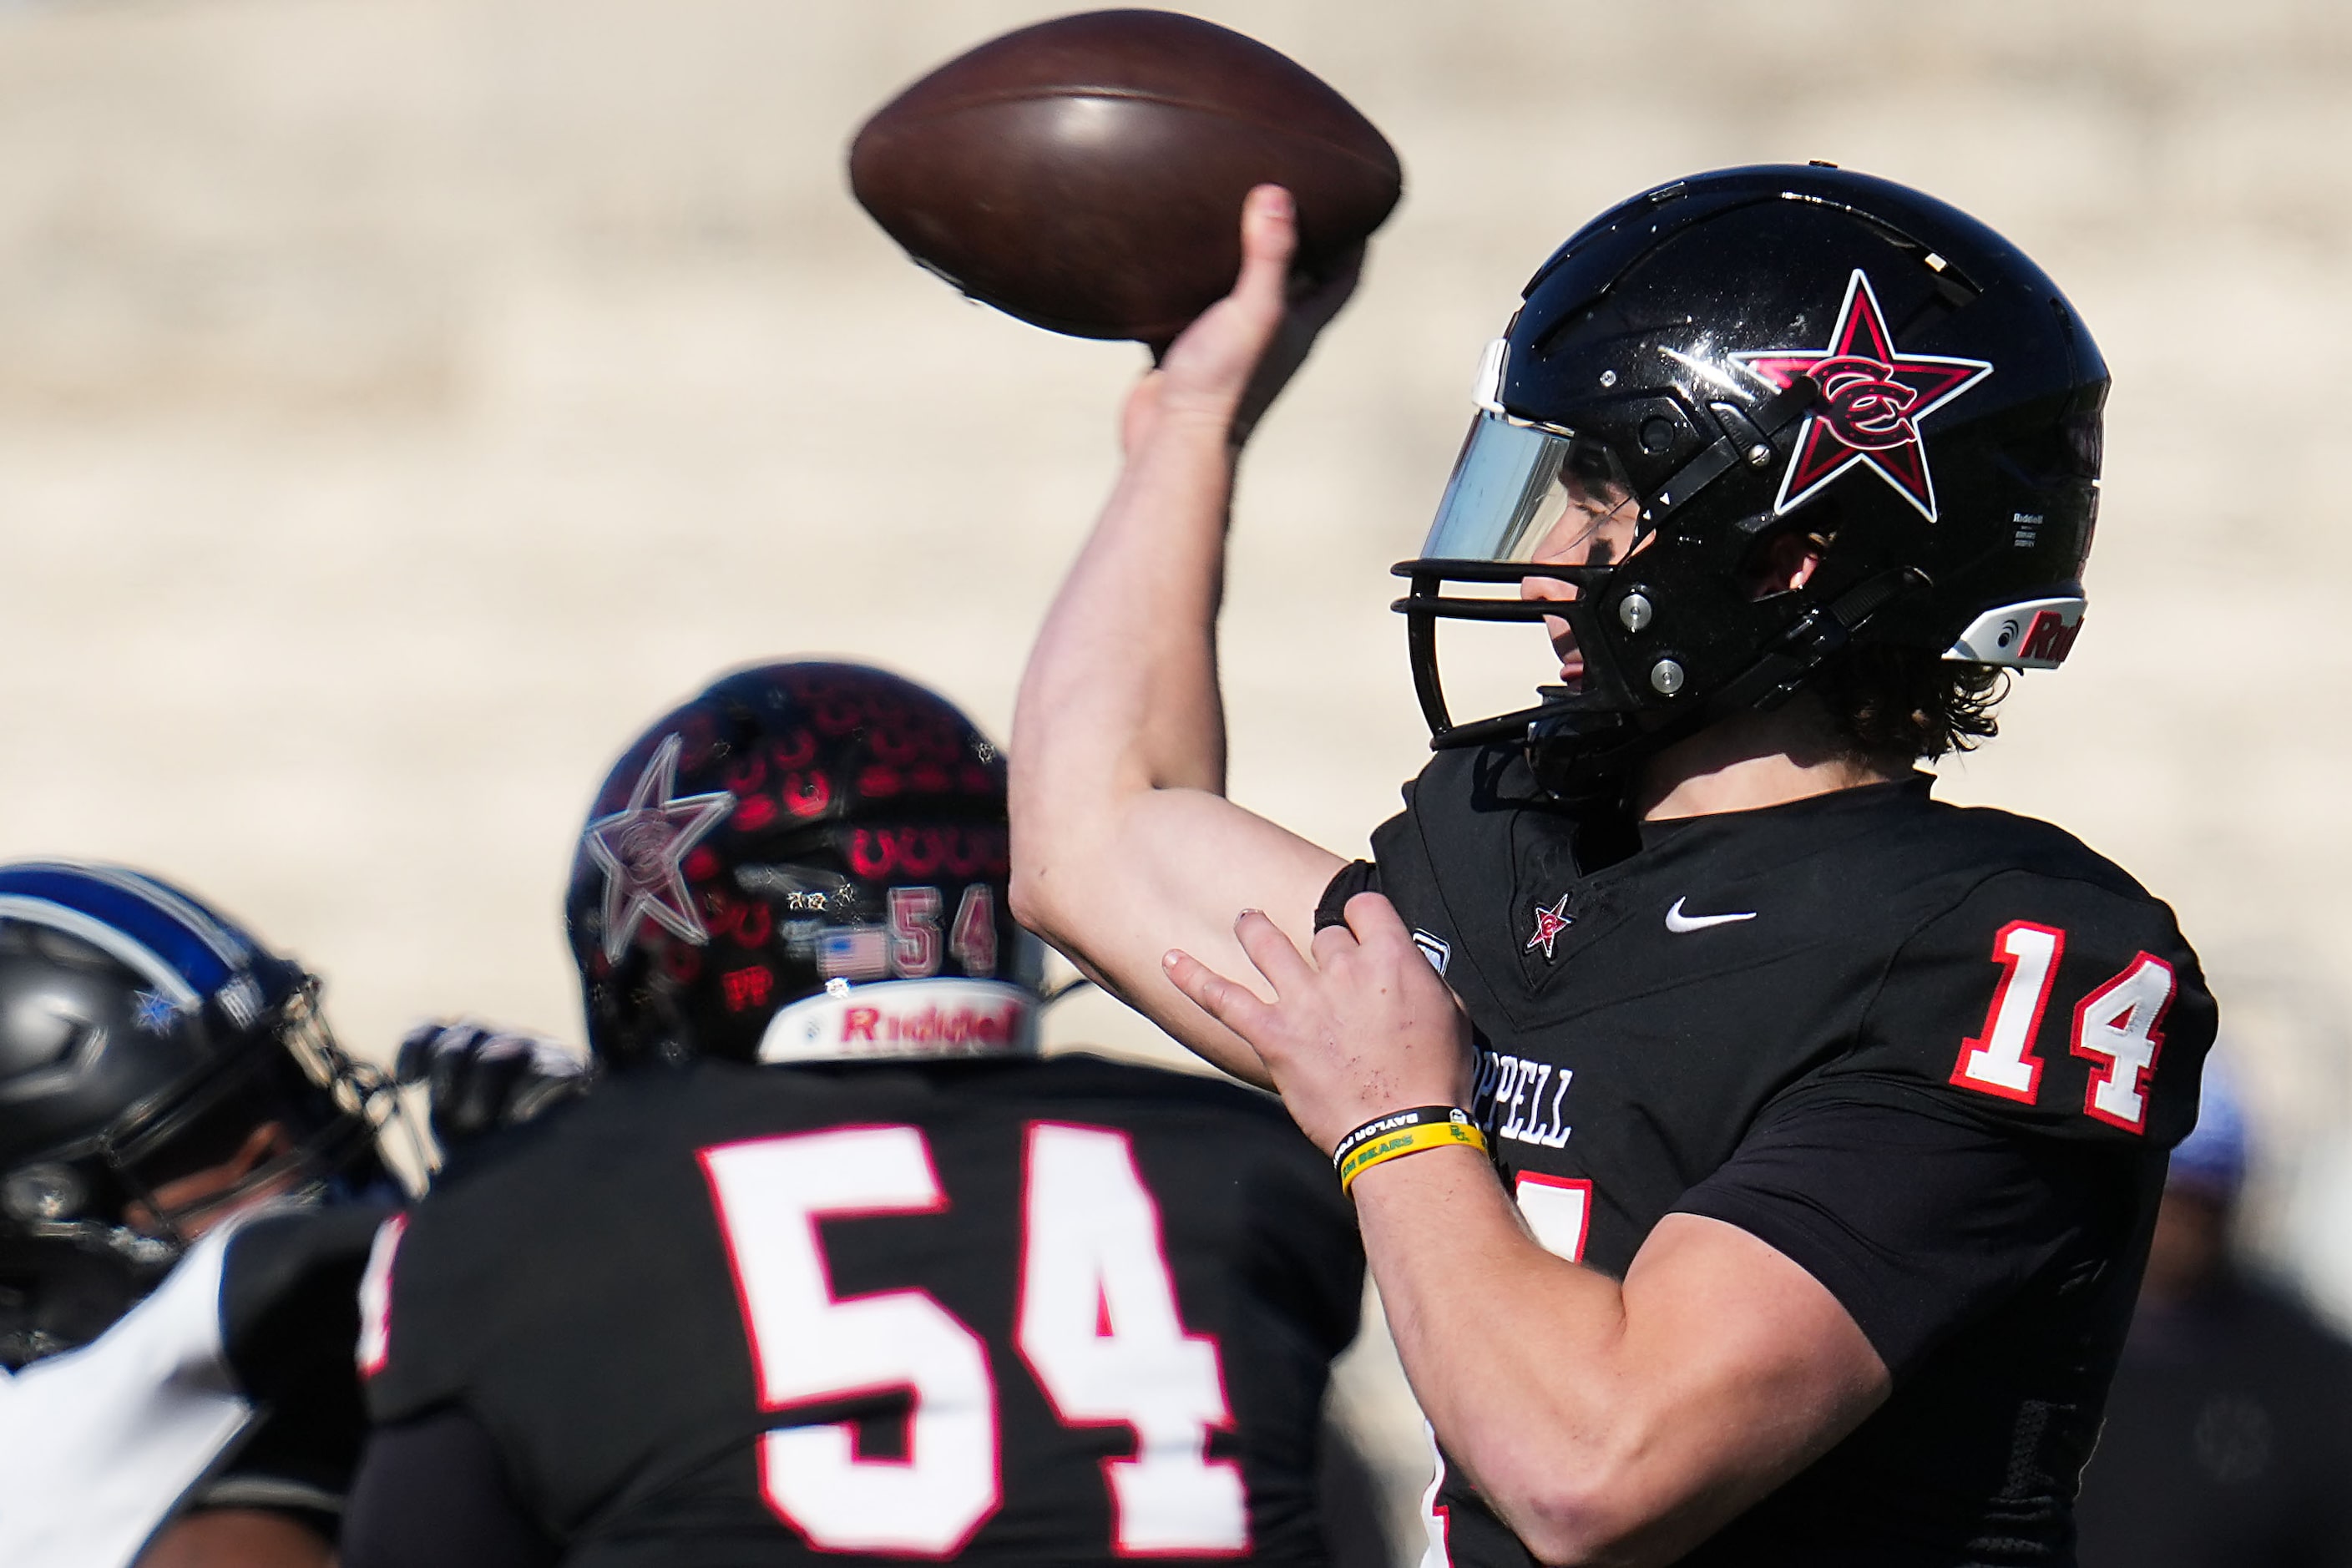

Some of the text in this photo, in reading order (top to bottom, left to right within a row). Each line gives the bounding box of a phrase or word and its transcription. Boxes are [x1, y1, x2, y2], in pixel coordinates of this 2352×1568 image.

[1949, 919, 2178, 1136] 14
[1355, 1112, 1419, 1141] BAYLOR
[1358, 1134, 1414, 1164] BEARS
[696, 1120, 1252, 1559] 54
